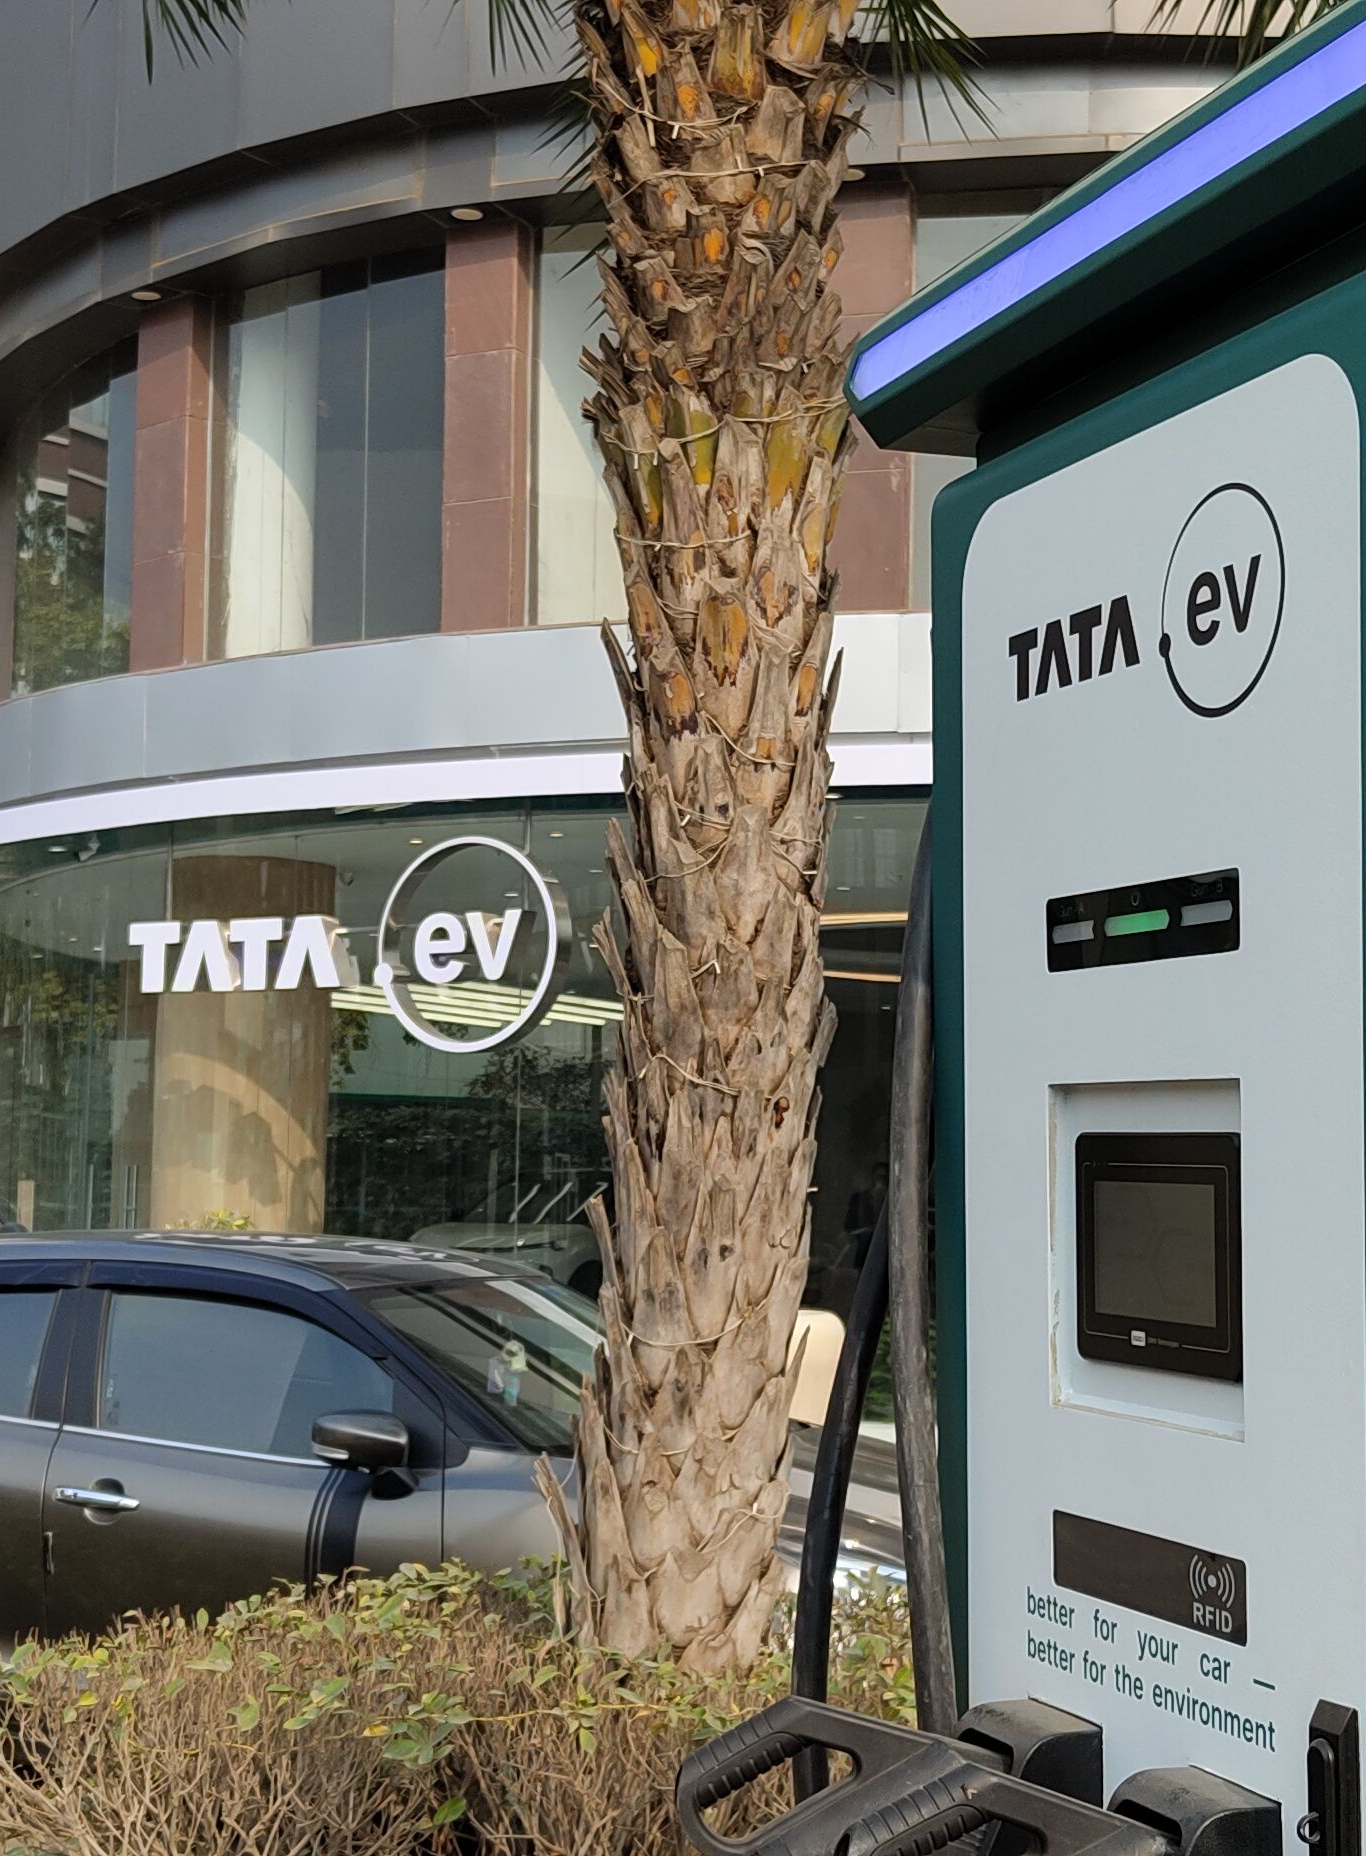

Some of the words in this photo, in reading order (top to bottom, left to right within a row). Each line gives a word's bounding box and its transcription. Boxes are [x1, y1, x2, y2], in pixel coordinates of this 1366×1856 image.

[1008, 595, 1140, 702] TATA
[128, 914, 341, 994] TATA
[1026, 1586, 1076, 1629] better
[1093, 1608, 1117, 1643] for
[1137, 1629, 1179, 1666] your
[1199, 1651, 1231, 1685] car
[1192, 1601, 1234, 1634] RFID
[1026, 1629, 1076, 1674] better
[1082, 1650, 1107, 1686] for
[1114, 1663, 1144, 1700] the
[1152, 1681, 1276, 1753] environment
